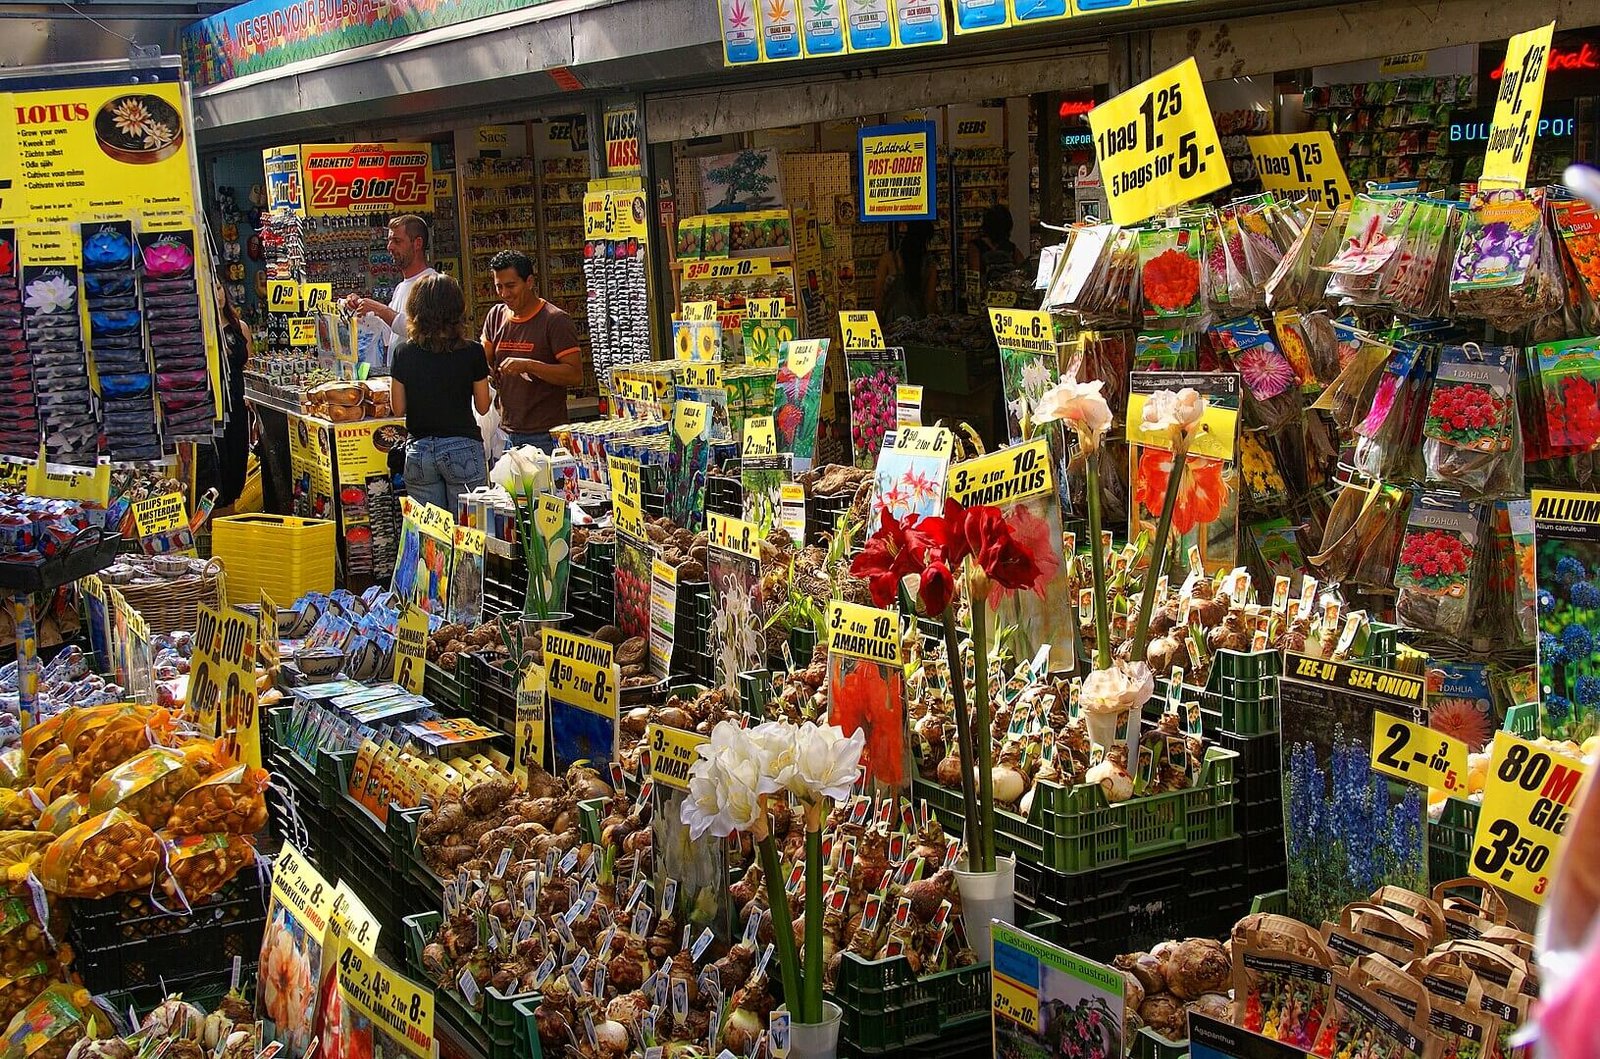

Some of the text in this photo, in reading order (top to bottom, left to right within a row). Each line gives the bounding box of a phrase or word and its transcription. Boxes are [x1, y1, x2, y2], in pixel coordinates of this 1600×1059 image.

[236, 21, 253, 47] WE
[254, 12, 282, 44] SEND
[285, 2, 315, 32] YOUR
[319, 0, 358, 25] BULBS
[1512, 44, 1546, 115] 1.25
[15, 102, 90, 125] LOTUS
[1098, 83, 1183, 161] 1 bag 1.25
[21, 129, 38, 137] Grow
[40, 129, 53, 138] your
[479, 131, 507, 143] Sacs
[958, 121, 987, 134] SEEDS
[23, 138, 56, 148] Kweek zelf
[46, 149, 64, 157] selbst
[873, 141, 913, 156] Laddrak
[309, 154, 426, 169] MAGNETIC MEMO HOLDERS
[868, 156, 923, 176] POST-ORDER
[1112, 131, 1215, 198] 5 bags for 5.-
[1256, 142, 1323, 183] 1 bag 1.25
[27, 171, 50, 179] Cultivez
[66, 180, 85, 188] stesso
[869, 176, 921, 188] WE SEND YOUR BULBS
[311, 172, 430, 206] 2.- 3 for 5.-
[869, 187, 899, 199] ALL OVER THE
[1306, 186, 1322, 203] for
[588, 201, 603, 213] LOTUS
[588, 216, 594, 234] 3
[594, 220, 605, 230] bags
[606, 213, 615, 233] 5.-
[1574, 222, 1593, 232] DAHLIA
[688, 260, 758, 279] 3.50 3 for 10.-
[684, 304, 716, 321] 3.50 10.-
[749, 300, 785, 319] 3.50 10.-
[848, 314, 869, 323] CYCLAMEN
[293, 326, 304, 340] 2.-
[995, 313, 1048, 339] 3.50 2 for 6.-
[846, 328, 883, 348] 2.- 3 for 5.-
[998, 335, 1054, 352] Garden Amaryllis
[1238, 336, 1257, 347] DAHLIA
[686, 368, 720, 386] 3.50 10.-
[1458, 370, 1490, 382] DAHLIA
[337, 428, 371, 438] LOTUS
[751, 419, 767, 428] CYCLAMEN
[744, 435, 755, 455] 2.-
[755, 444, 759, 454] 3
[898, 428, 948, 452] 3.50 2 for 6.-
[954, 448, 1045, 493] 3.- 4 for 10.-
[961, 470, 1046, 509] AMARYLLIS
[136, 498, 177, 513] TULIPS from
[618, 494, 635, 509] CYCLAMEN
[1535, 497, 1600, 522] ALLIUM
[138, 503, 182, 522] AMSTERDAM
[1430, 516, 1460, 526] DAHLIA
[710, 517, 757, 554] 3.- 3 for 8.-
[1536, 522, 1587, 533] Allium caeruleum
[195, 609, 217, 656] 100
[832, 608, 897, 640] 3.- 4 for 10.-
[222, 618, 246, 666] 100
[546, 634, 612, 669] BELLA DONNA
[832, 632, 897, 661] AMARYLLIS
[550, 658, 613, 705] 4.50 2 for 8.-
[1296, 659, 1337, 681] ZEE-UI
[1348, 669, 1421, 700] SEA-ONION
[1444, 684, 1473, 694] DAHLIA
[654, 730, 692, 760] 3.- 4 for
[1377, 723, 1465, 793] 2.- 3 for 5.-
[1498, 744, 1552, 791] 80
[1474, 819, 1550, 882] 3.50
[278, 852, 325, 909] 4.50 2 for 8.-
[1533, 876, 1549, 896] 3
[274, 874, 305, 912] AMARYLLIS
[304, 904, 326, 933] JUMBO
[332, 892, 350, 917] 4.50
[357, 920, 371, 947] 8.-
[340, 946, 368, 986] 4.50 2
[1000, 929, 1119, 989] (Castanospermum australe)
[372, 970, 427, 1025] 4.50 2 for 8.-
[372, 1000, 432, 1052] AMARYLLIS JUMBO
[1020, 1006, 1036, 1026] 10.-
[1194, 1024, 1236, 1046] Agapanthus
